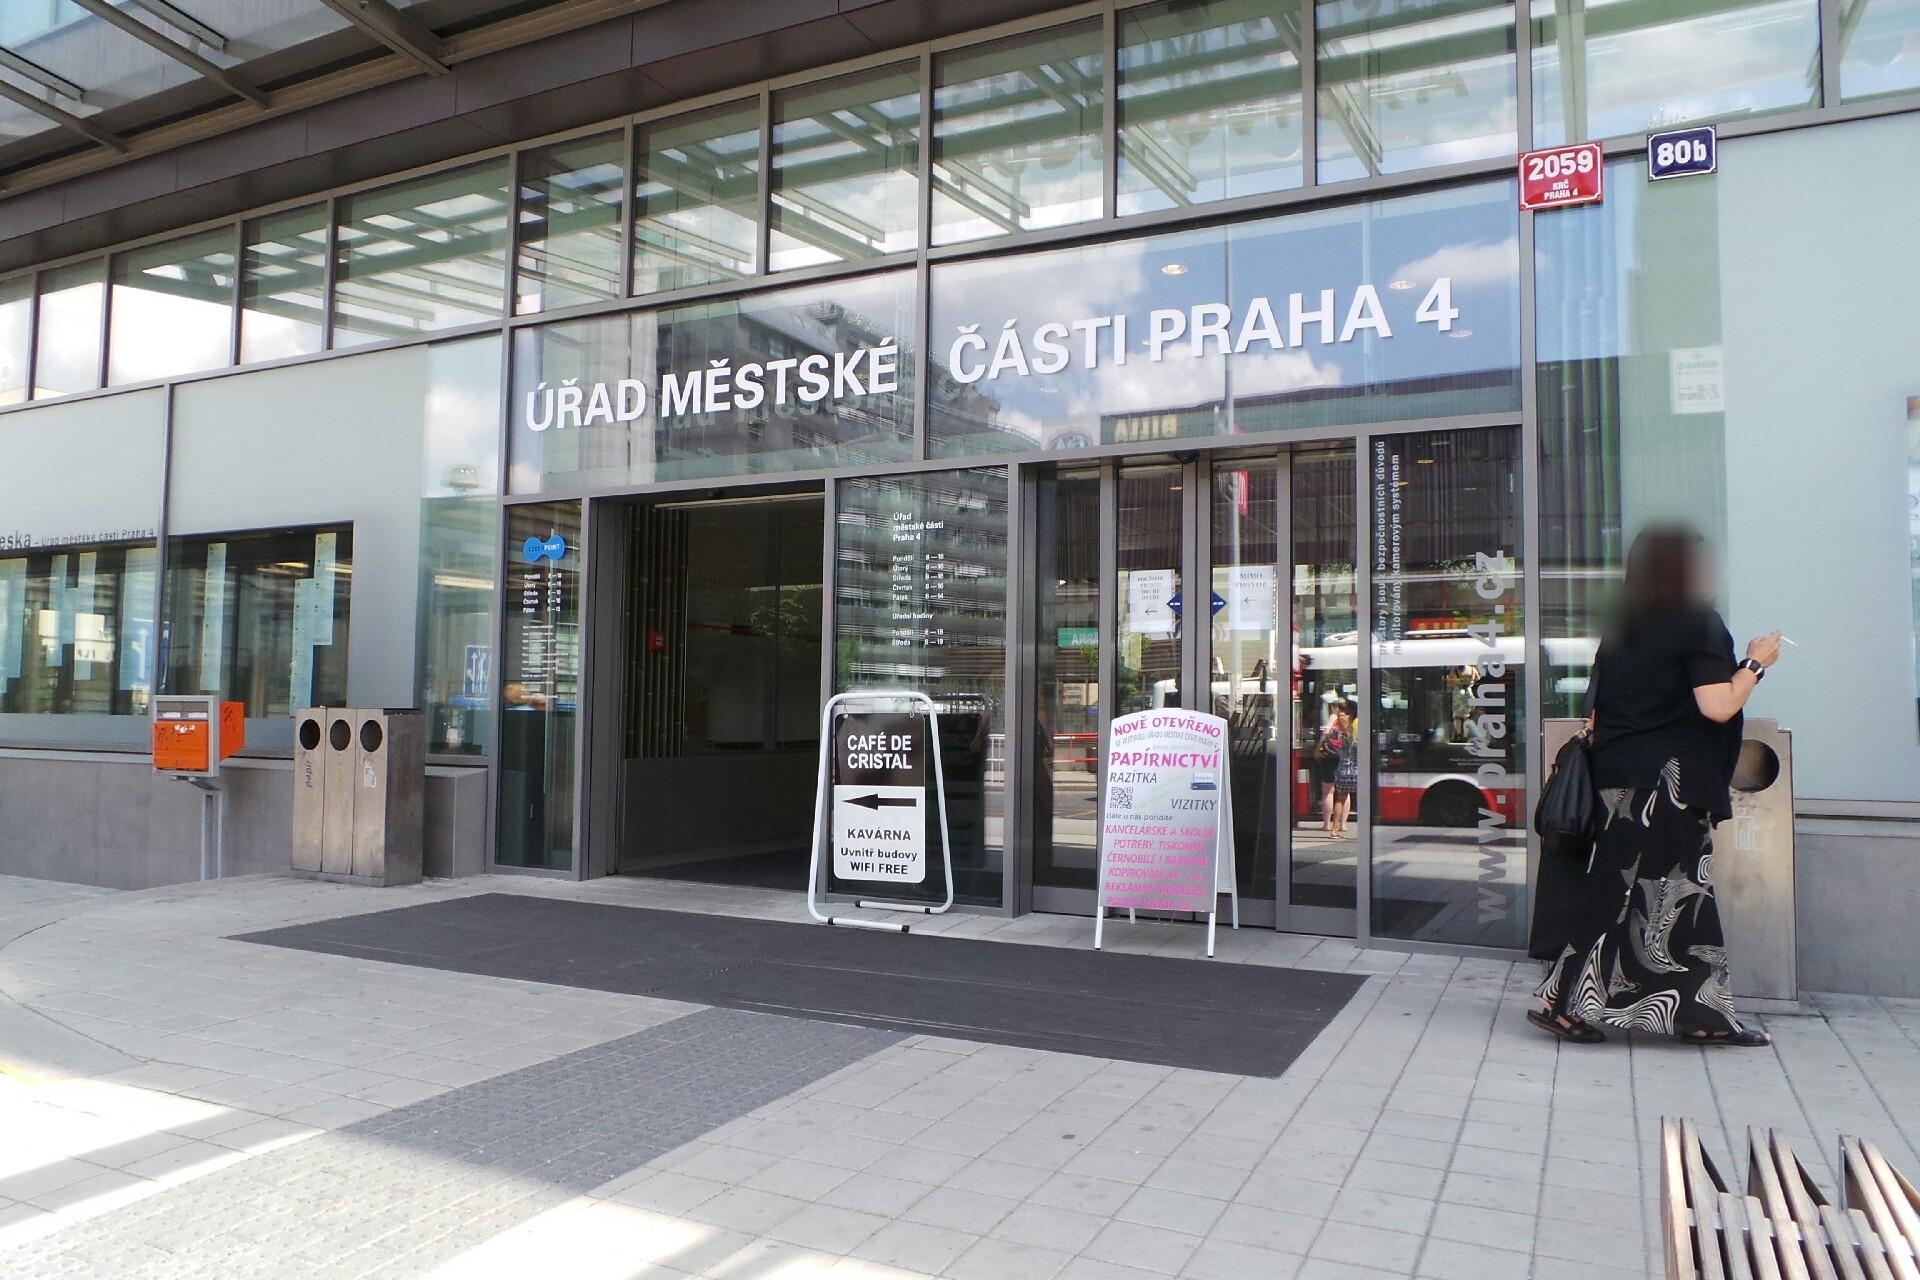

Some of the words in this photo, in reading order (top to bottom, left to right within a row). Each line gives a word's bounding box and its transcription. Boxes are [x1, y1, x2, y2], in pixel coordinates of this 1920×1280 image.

[1657, 139, 1707, 167] 80b
[1528, 150, 1594, 181] 2059
[1544, 190, 1571, 200] PRAHA
[1572, 188, 1579, 197] 4
[1552, 179, 1570, 191] KRČ
[526, 376, 646, 433] ÚŘAD
[661, 336, 898, 419] MĚSTSKÉ
[949, 317, 1127, 385] ČÁSTI
[1149, 283, 1394, 363] PRAHA
[1415, 276, 1460, 332] 4
[1375, 441, 1385, 480] důvodů
[1389, 454, 1402, 510] systémem
[893, 533, 915, 541] Praha
[1375, 483, 1387, 571] bezpečnostních
[1389, 513, 1402, 576] kamerovým
[1114, 715, 1148, 737] NOVĚ
[1152, 716, 1221, 738] OTEVŘENO
[847, 732, 887, 751] CAFÉ
[891, 735, 912, 751] DE
[1467, 550, 1508, 925] www.praha4.cz
[847, 753, 912, 770] CRISTAL
[1110, 747, 1221, 768] PAPÍRNICTVÍ
[1109, 770, 1158, 784] RAZÍTKA
[1171, 798, 1217, 811] VIZITKY
[847, 826, 911, 841] KAVÁRNA
[840, 847, 874, 858] Uvnitř
[877, 848, 918, 862] budovy
[850, 861, 876, 873] WIFI
[878, 863, 909, 875] FREE
